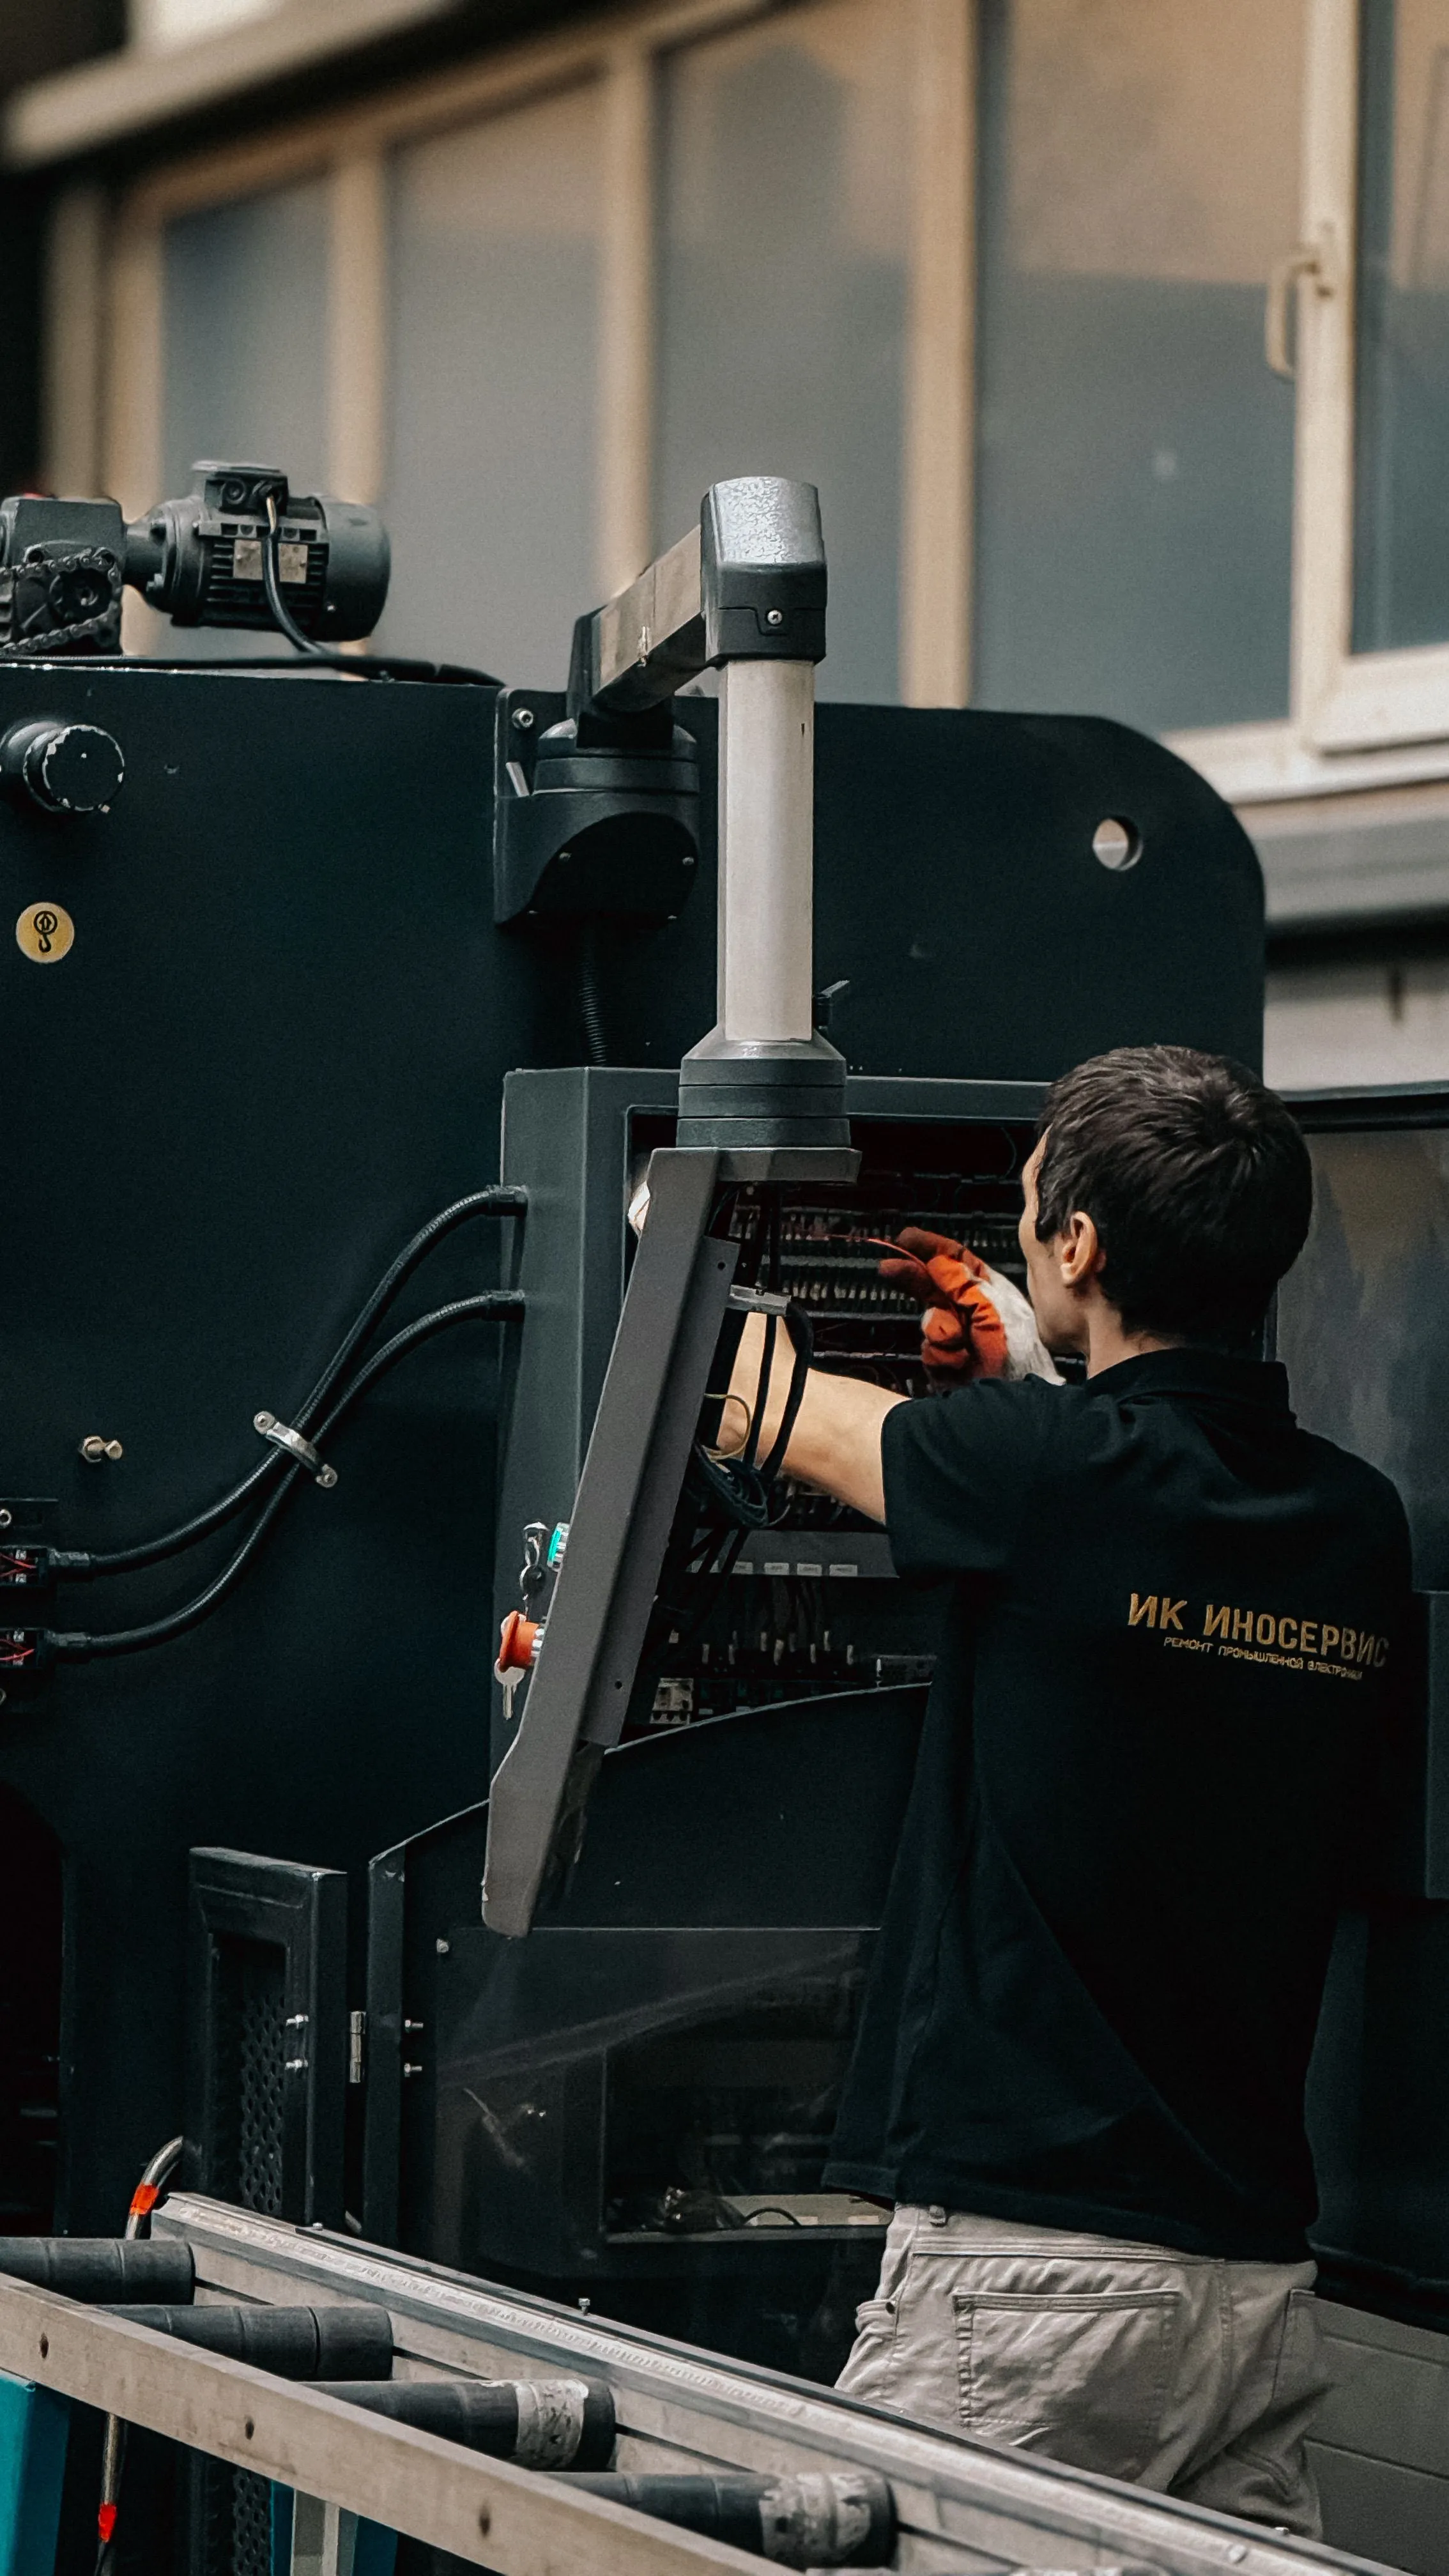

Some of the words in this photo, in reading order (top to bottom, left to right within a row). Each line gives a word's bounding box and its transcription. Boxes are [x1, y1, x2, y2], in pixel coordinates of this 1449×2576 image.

[1128, 1592, 1188, 1630] ИК
[1203, 1604, 1390, 1668] ИНОСЕРВИС
[1163, 1637, 1214, 1653] РЕМОНТ
